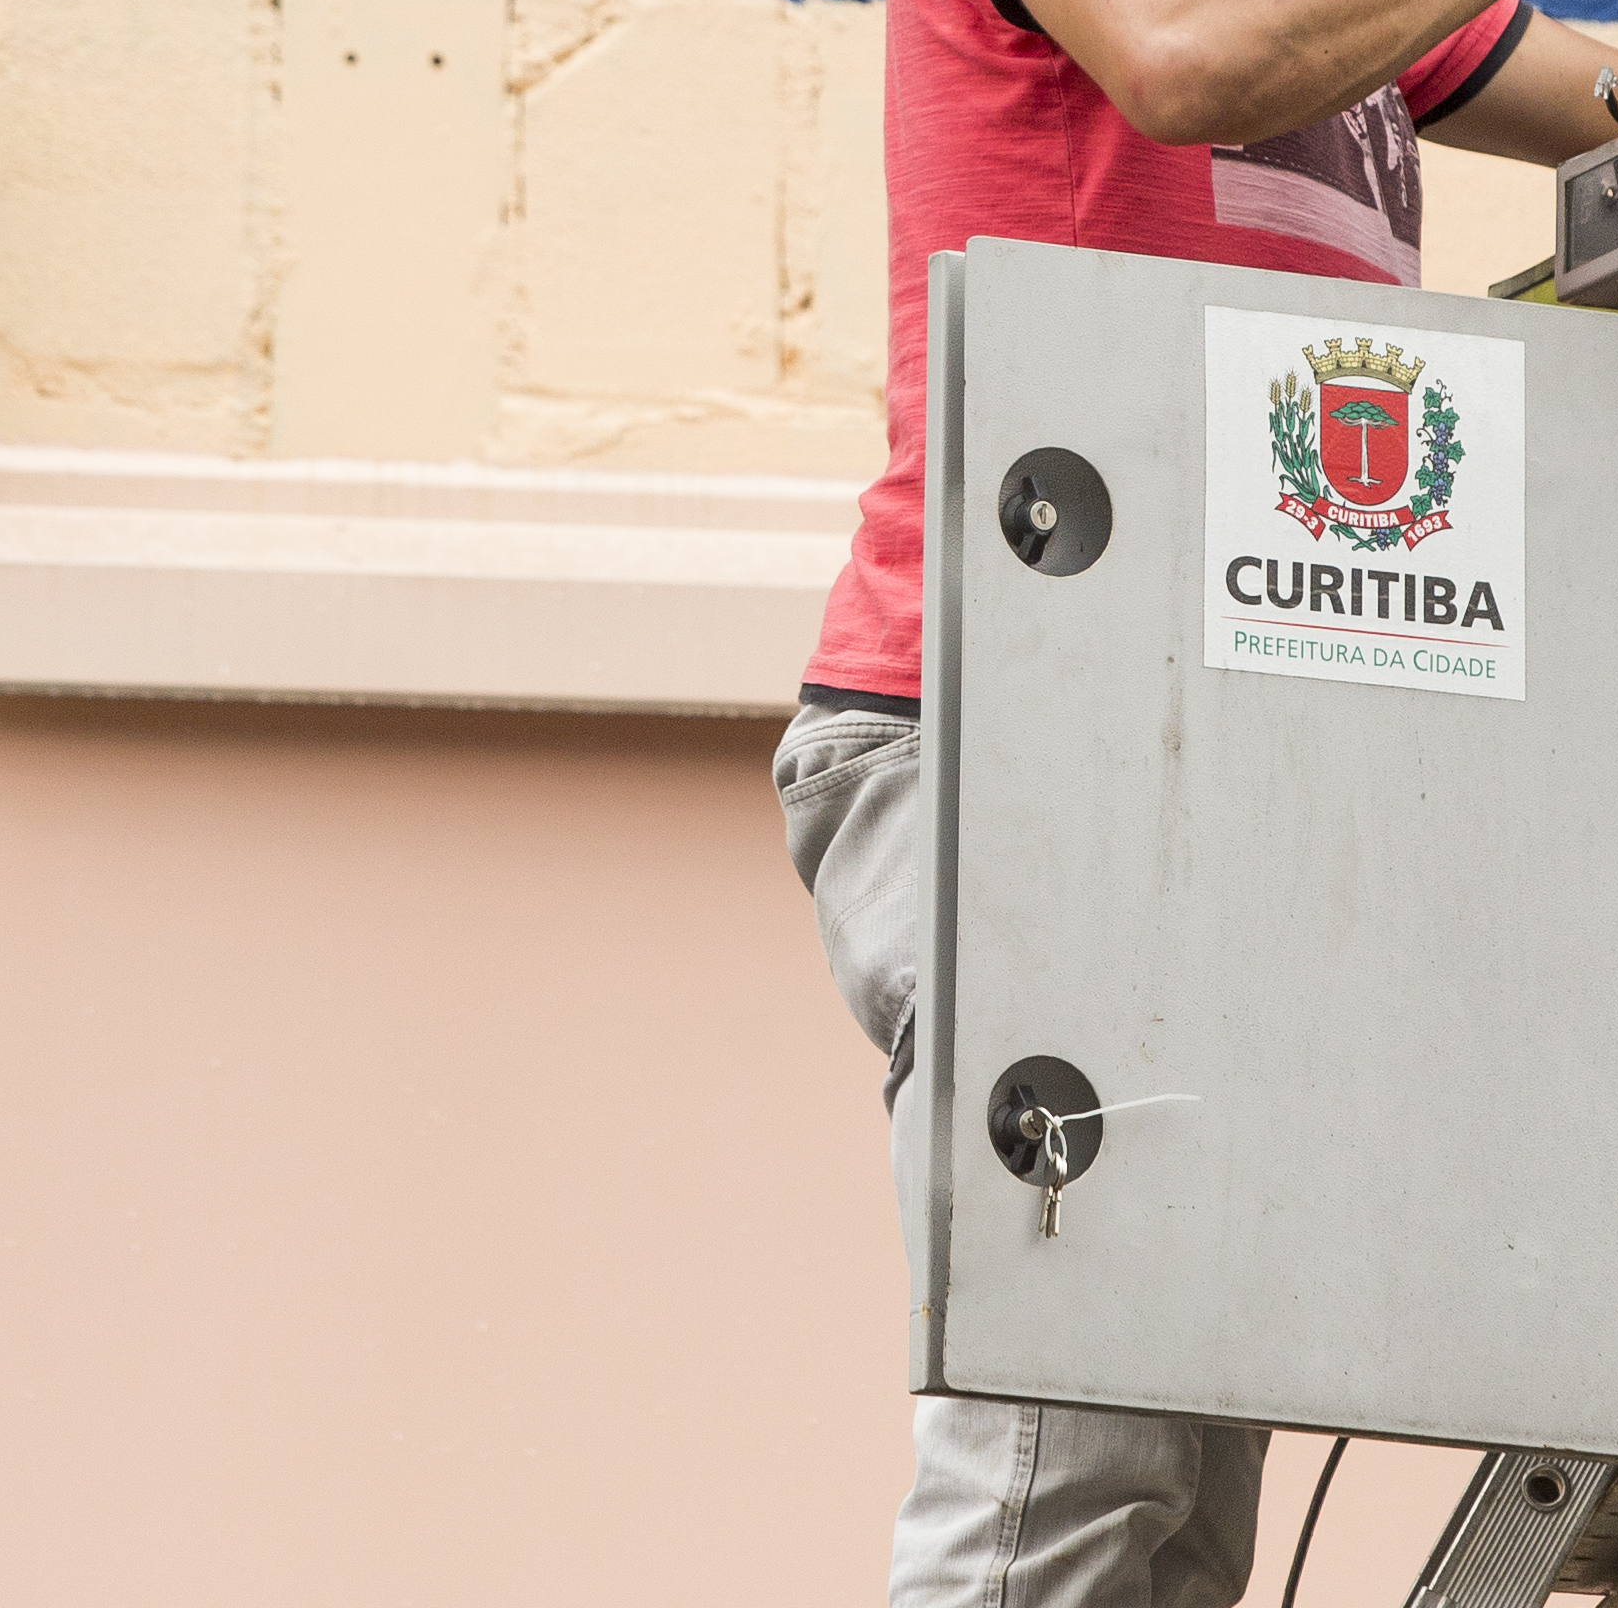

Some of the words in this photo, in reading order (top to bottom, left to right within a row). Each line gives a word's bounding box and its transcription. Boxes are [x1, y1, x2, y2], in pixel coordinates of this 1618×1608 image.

[1285, 500, 1318, 530] 29-3
[1328, 505, 1400, 527] CURITIBA
[1407, 516, 1442, 542] 1693
[1225, 555, 1505, 631] CURITIBA
[1234, 630, 1366, 665] PREFEITURA
[1373, 647, 1406, 669] DA
[1412, 649, 1496, 679] CIDADE
